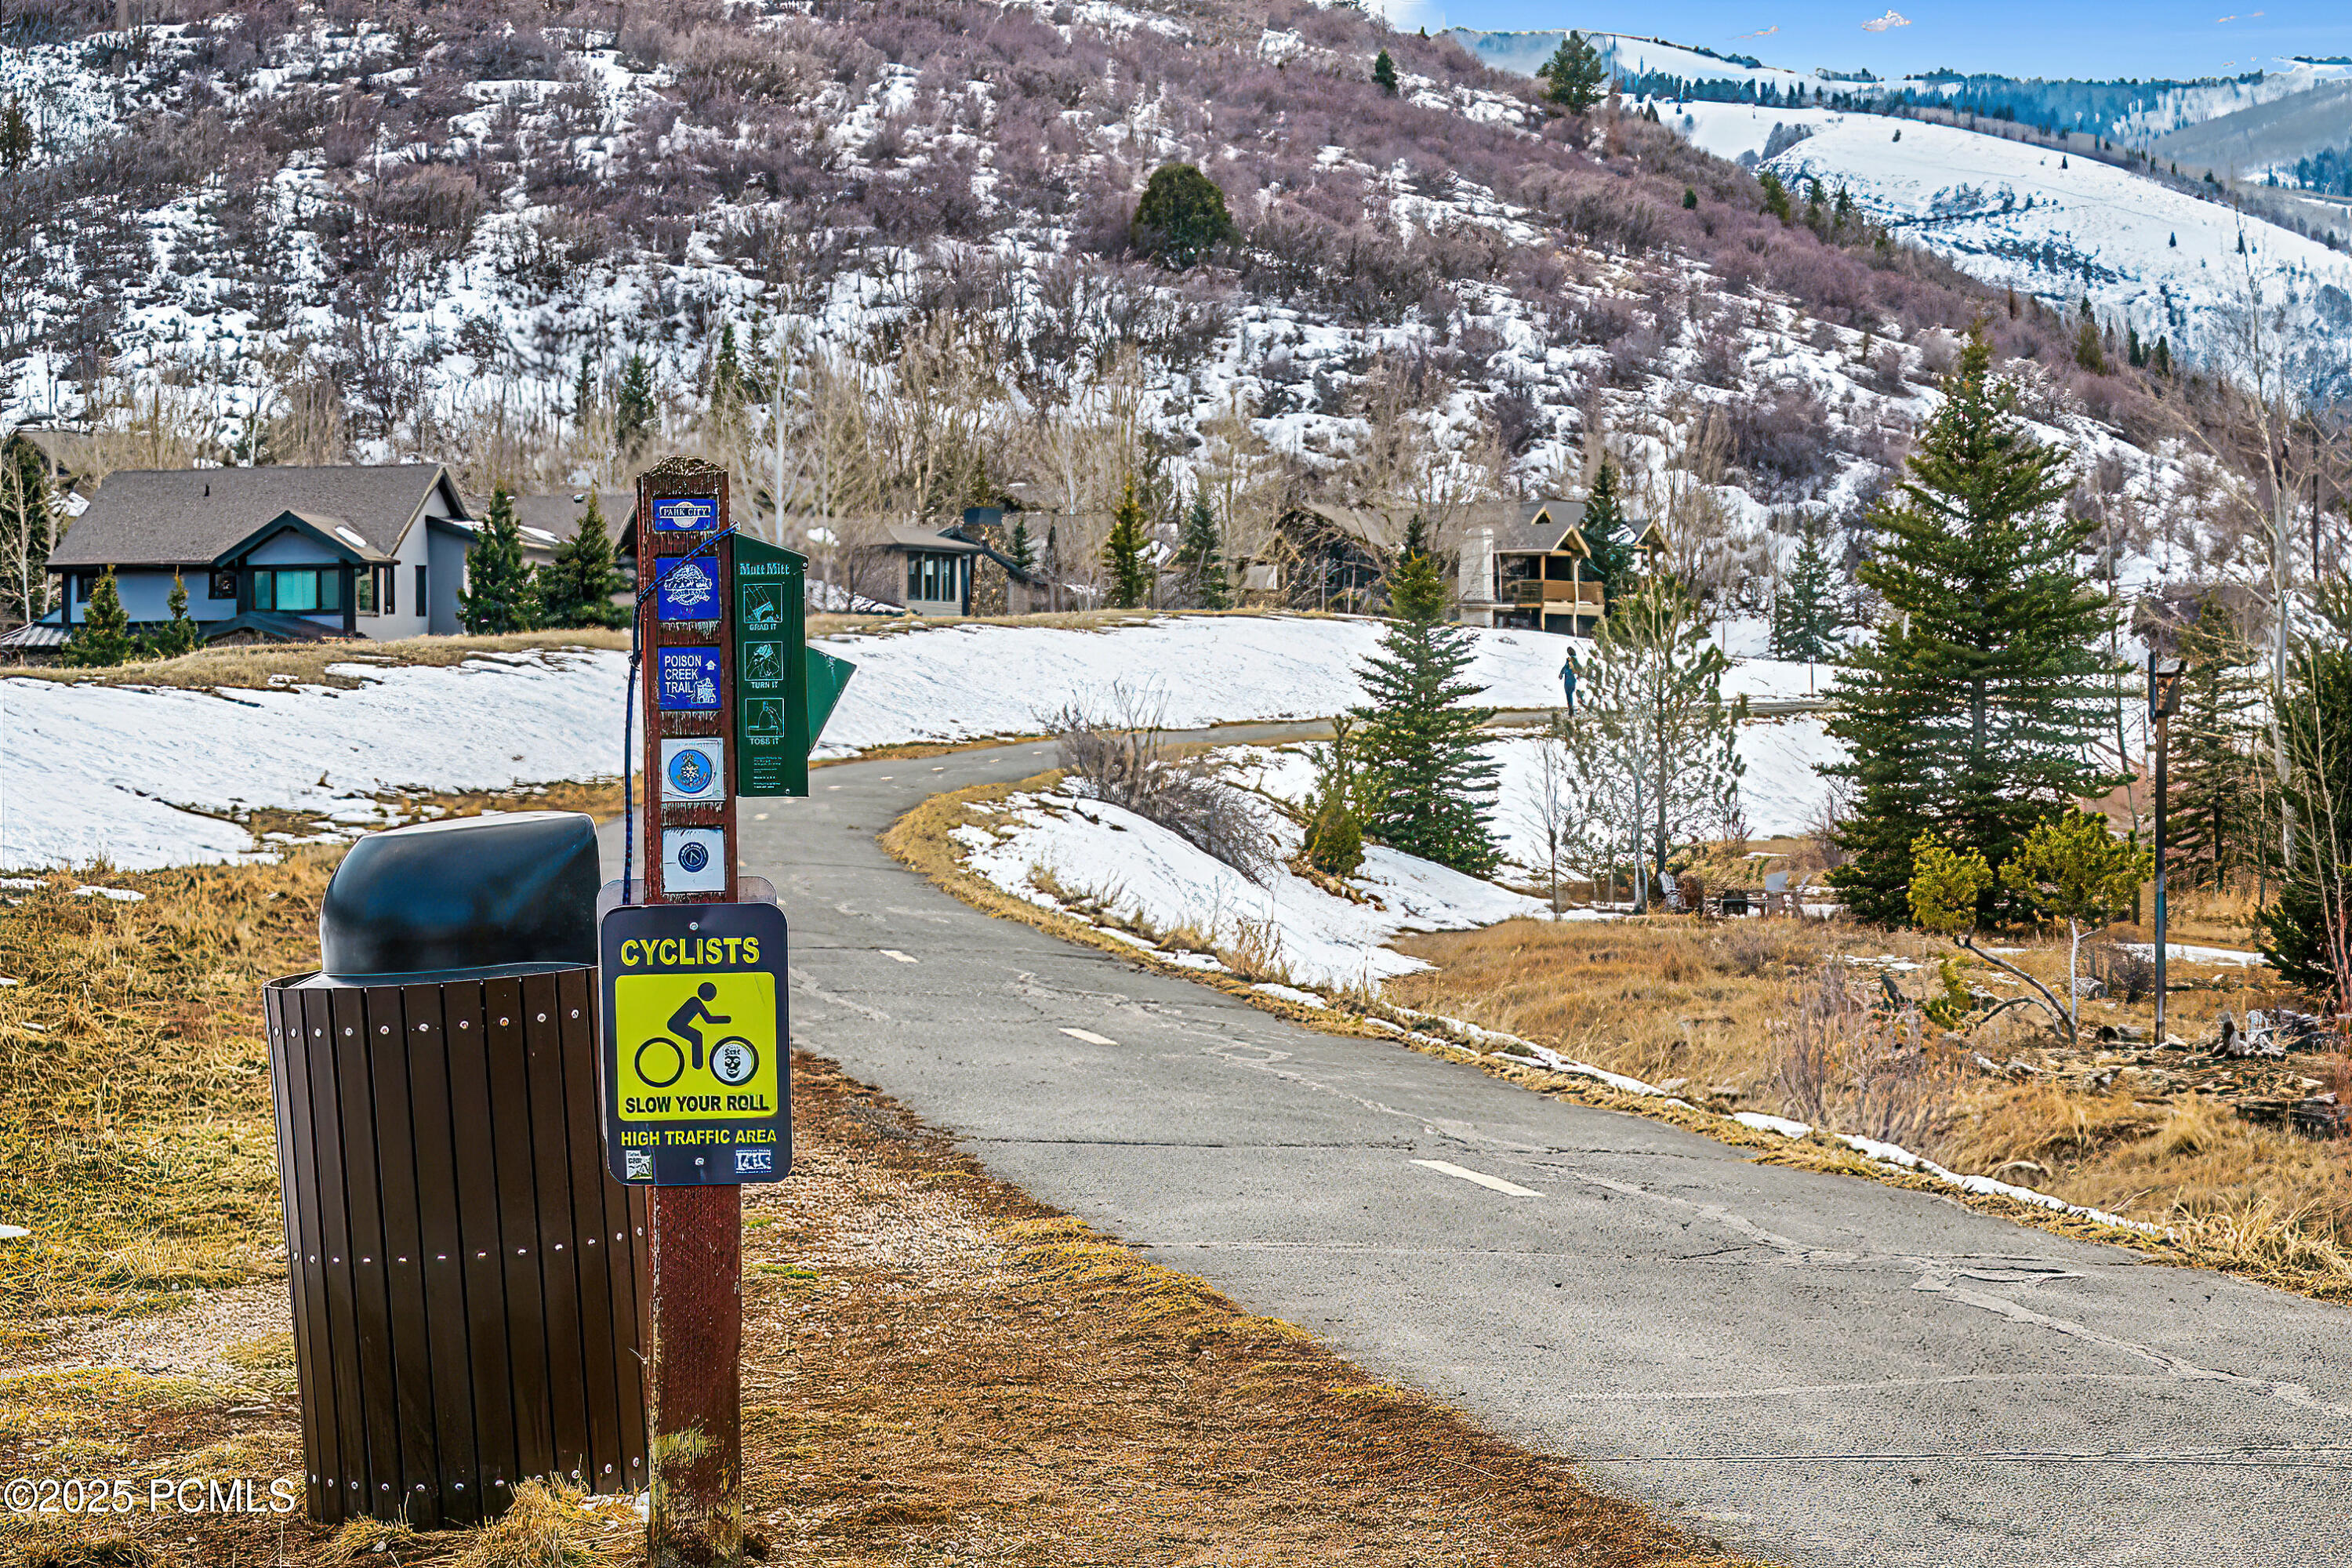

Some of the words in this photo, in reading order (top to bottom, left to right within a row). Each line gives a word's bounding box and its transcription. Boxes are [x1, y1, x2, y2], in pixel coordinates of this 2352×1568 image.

[663, 508, 685, 517] PARK
[664, 655, 702, 667] POISON
[665, 668, 699, 681] CREEK
[665, 681, 694, 693] TRAIL
[621, 937, 760, 966] CYCLISTS
[625, 1096, 671, 1113] SLOW
[677, 1095, 721, 1112] YOUR
[727, 1094, 769, 1111] ROLL
[621, 1131, 660, 1146] HIGH
[665, 1130, 731, 1145] TRAFFIC
[735, 1129, 777, 1143] AREA
